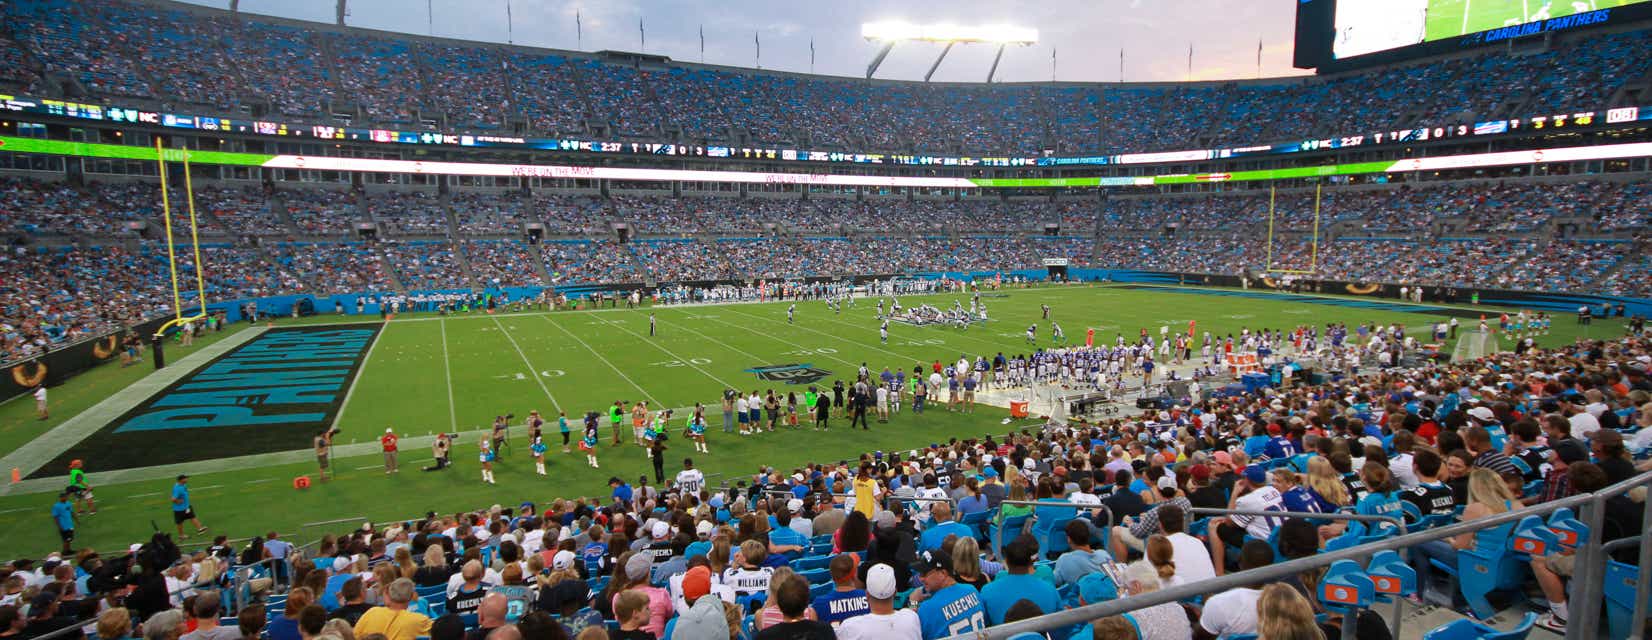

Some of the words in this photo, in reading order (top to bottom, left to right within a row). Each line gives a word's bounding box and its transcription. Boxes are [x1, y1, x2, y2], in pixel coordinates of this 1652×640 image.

[1485, 20, 1542, 42] CAROLINA
[1544, 9, 1610, 32] PANTHERS
[1341, 136, 1363, 146] 2:37
[601, 142, 621, 152] 2:37
[683, 480, 698, 492] 90
[738, 578, 768, 588] WILLIAMS
[829, 596, 869, 614] WATKINS
